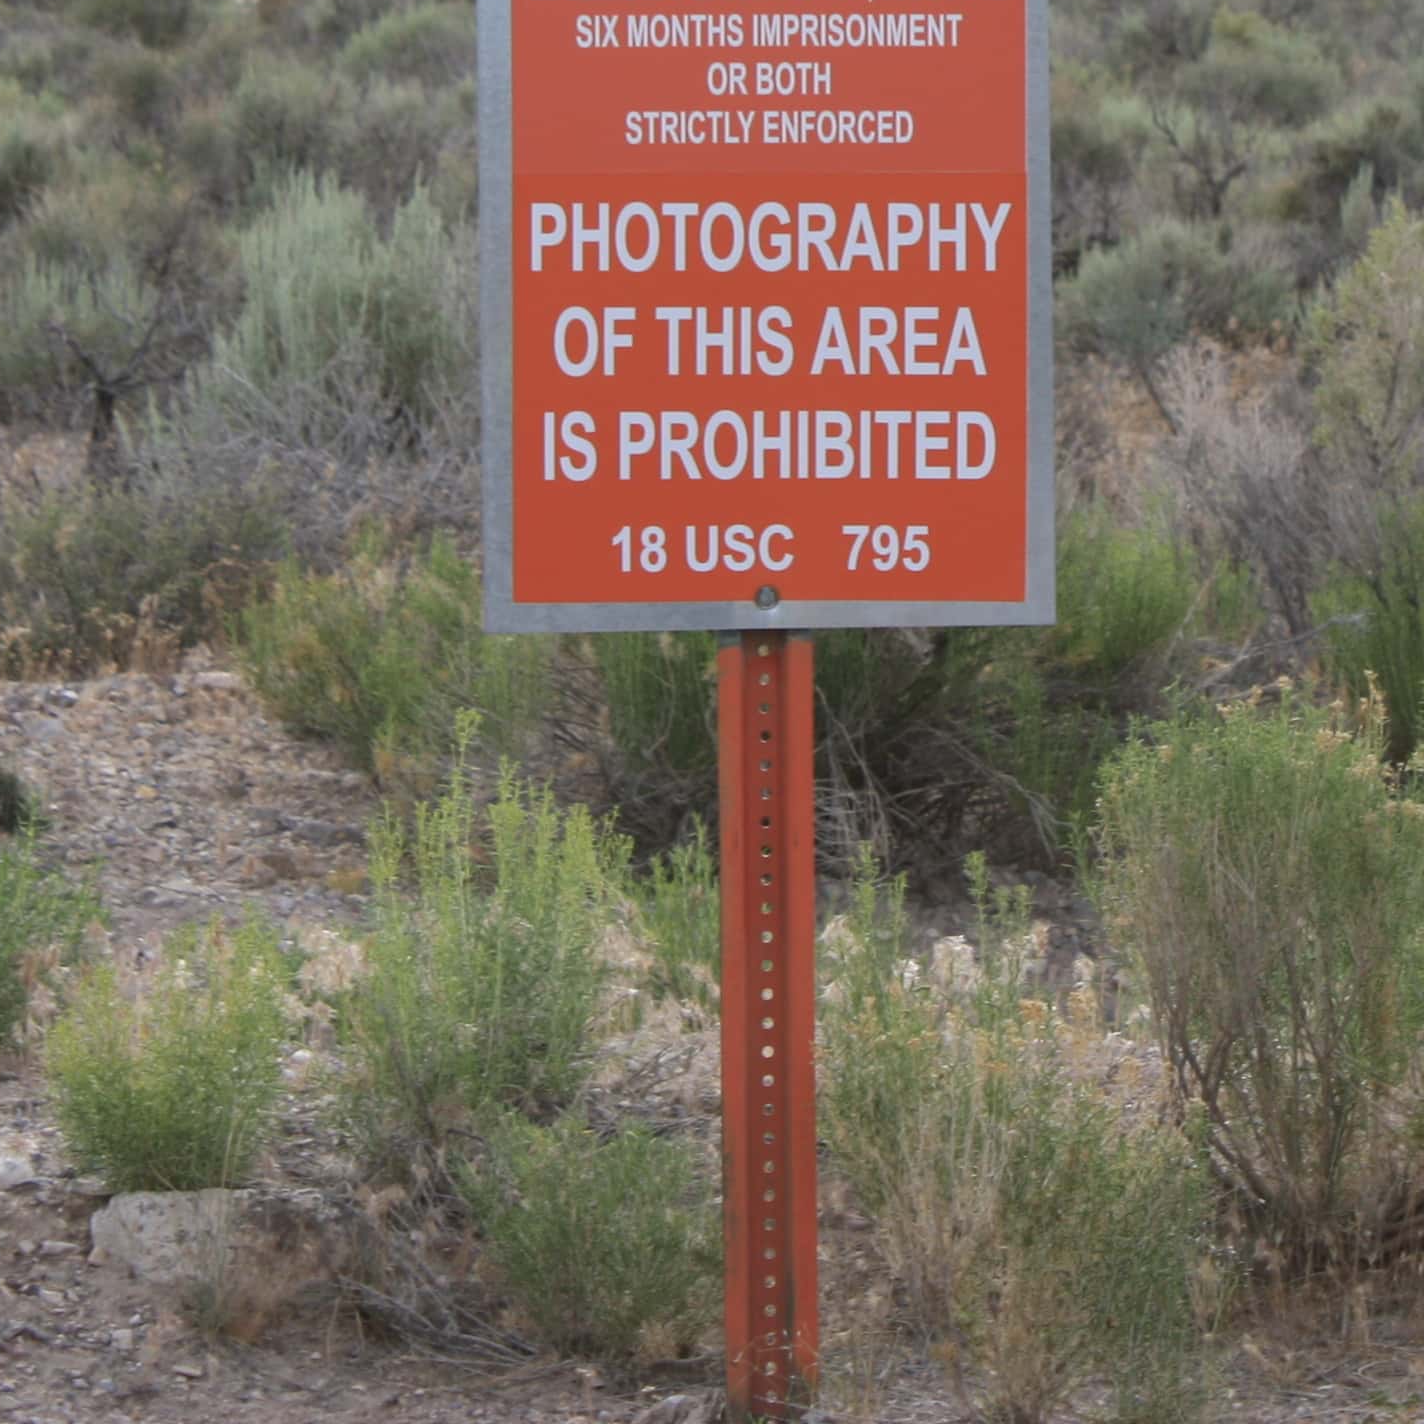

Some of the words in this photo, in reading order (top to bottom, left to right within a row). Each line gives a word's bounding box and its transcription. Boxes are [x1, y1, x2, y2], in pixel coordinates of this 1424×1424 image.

[575, 14, 620, 49] SIX
[627, 13, 744, 48] MONTHS
[752, 13, 963, 48] IMPRISONMENT
[707, 61, 749, 96] OR
[756, 61, 832, 96] BOTH
[625, 110, 756, 145] STRICTLY
[763, 109, 914, 144] ENFORCED
[530, 201, 1012, 273] PHOTOGRAPHY
[553, 305, 637, 377] OF
[655, 305, 795, 377] THIS
[810, 306, 988, 376] AREA
[543, 410, 598, 482] IS
[619, 409, 997, 481] PROHIBITED
[612, 525, 668, 573] 18
[685, 523, 795, 573] USC
[842, 524, 931, 572] 795
